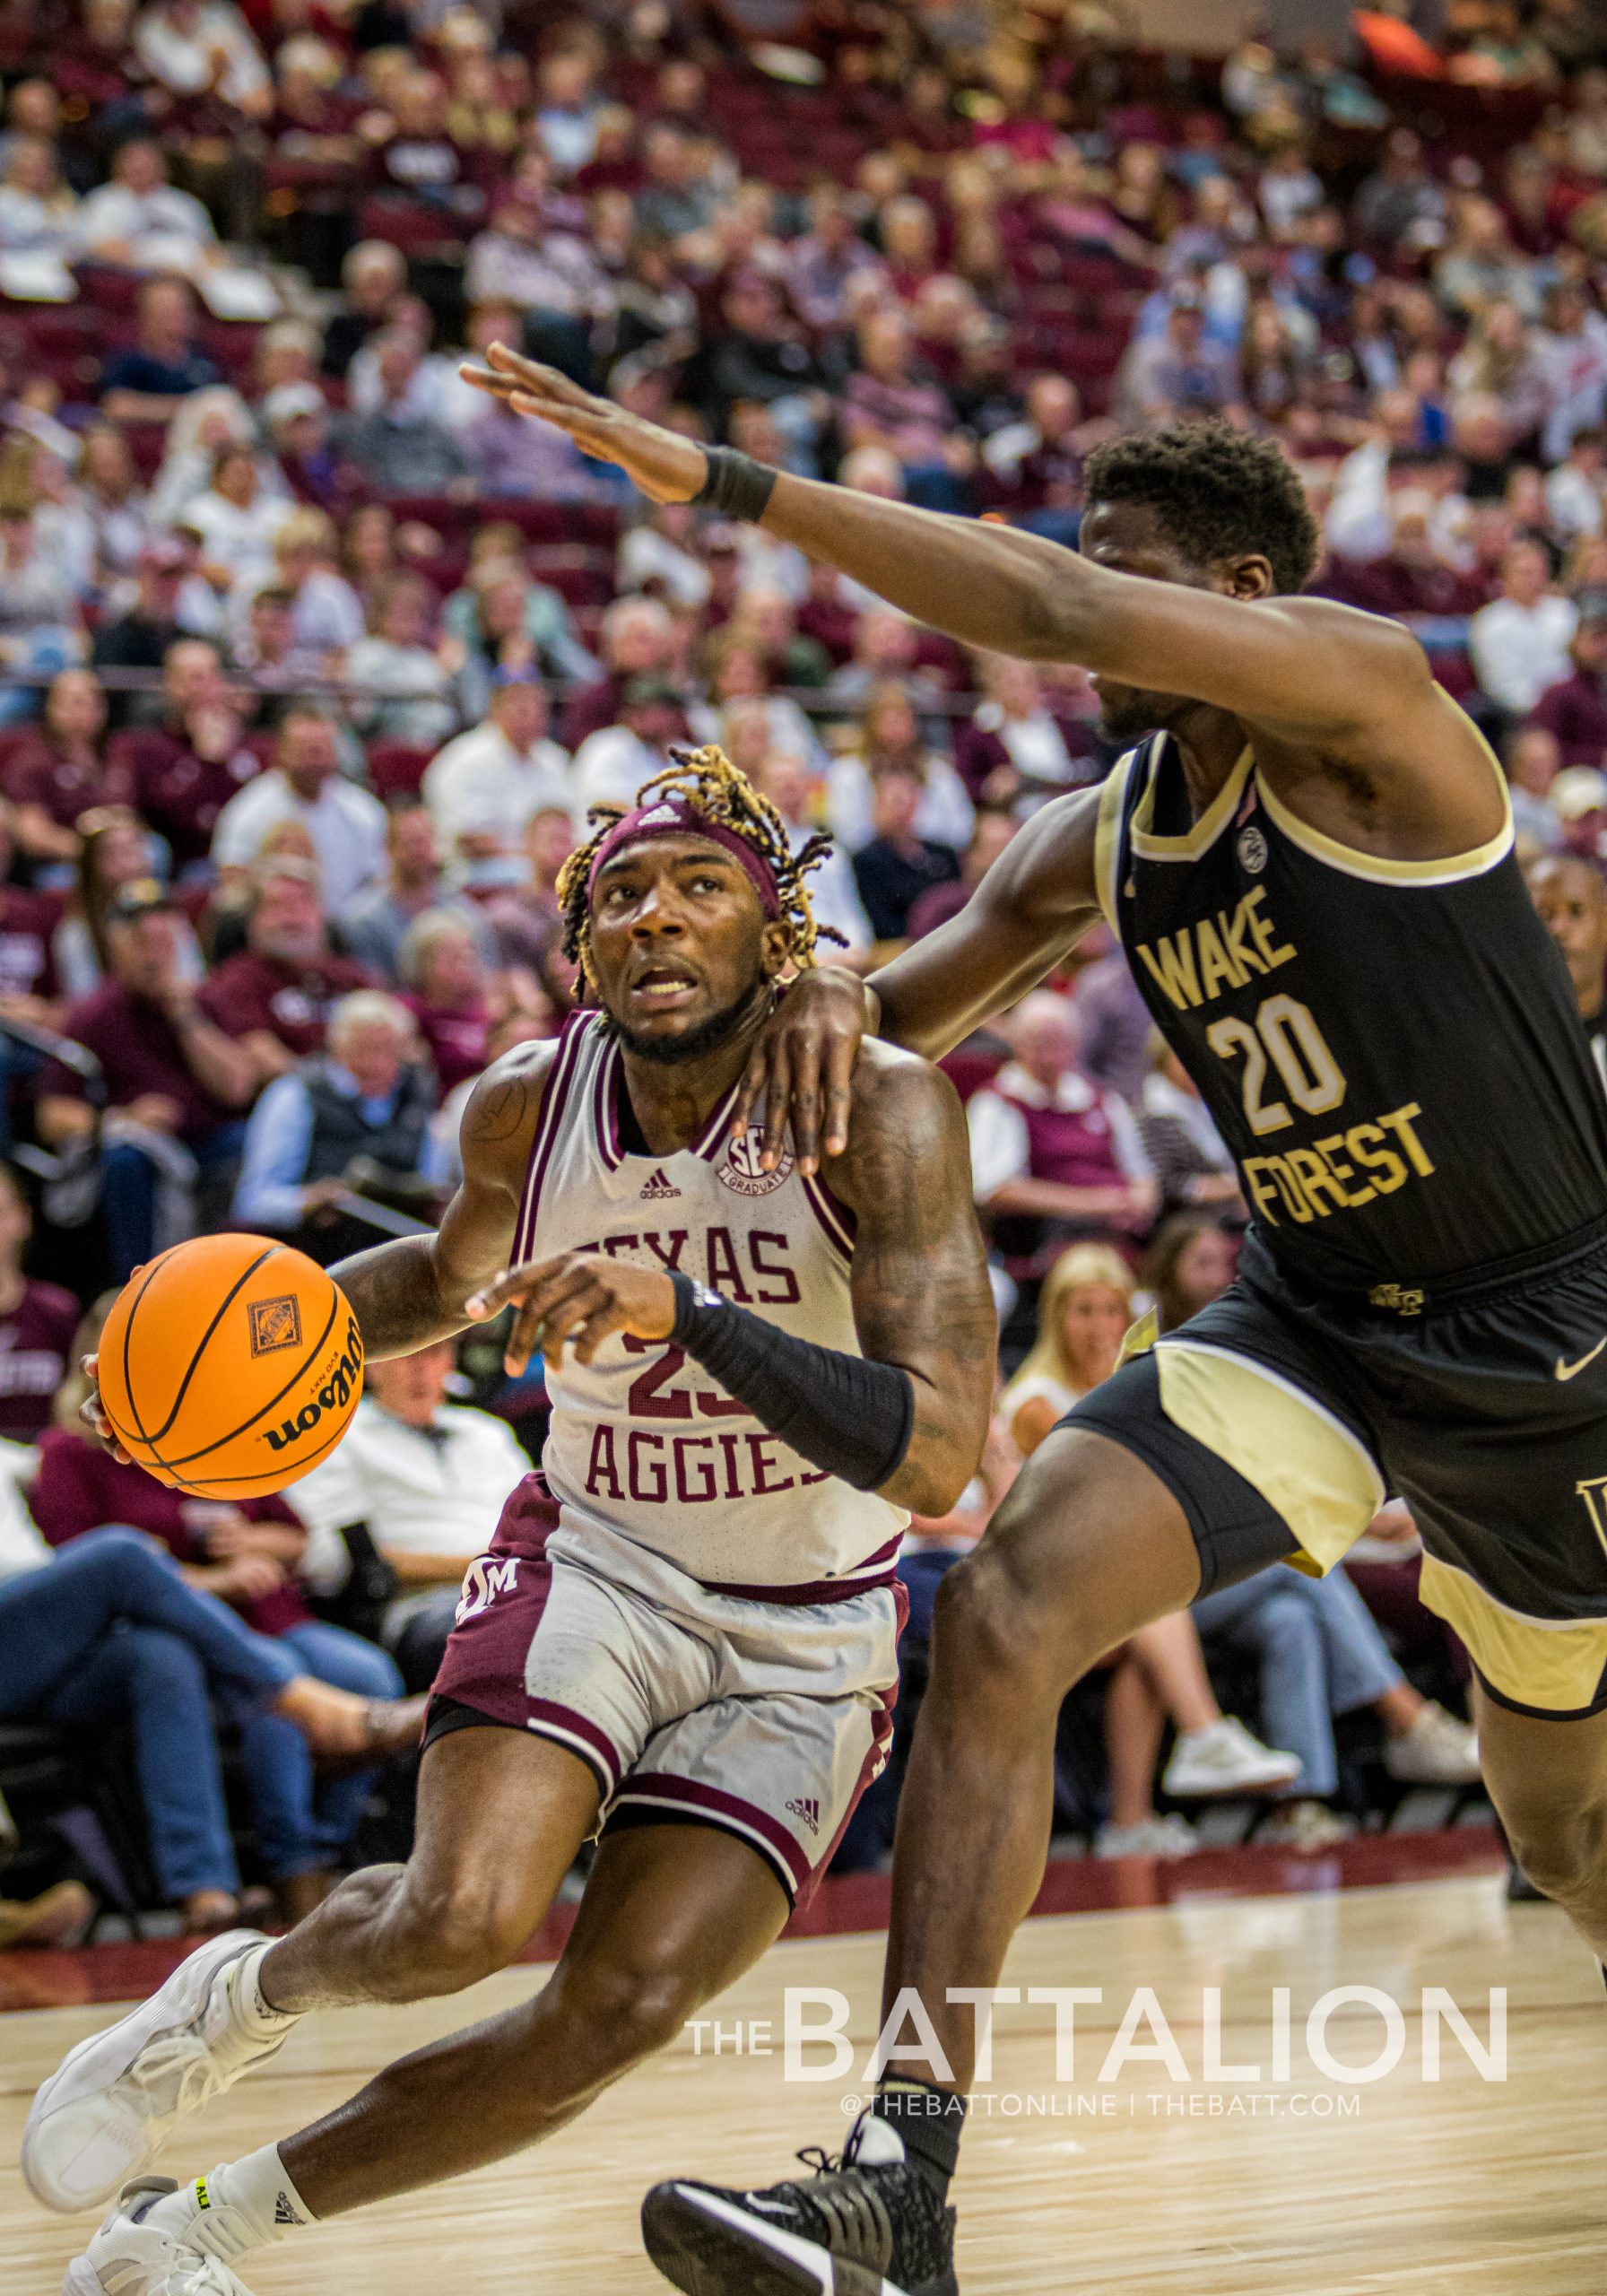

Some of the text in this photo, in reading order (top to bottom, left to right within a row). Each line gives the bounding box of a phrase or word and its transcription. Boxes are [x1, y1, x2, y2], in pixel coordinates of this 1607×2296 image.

[1135, 885, 1299, 1011] WAKE
[1205, 993, 1346, 1136] 20
[729, 1126, 765, 1177] SE
[1242, 1102, 1436, 1227] FOREST
[640, 1187, 682, 1199] adidas
[572, 1227, 801, 1303] XAS
[263, 1316, 364, 1451] Wilson
[310, 1351, 339, 1395] EVO NXT
[622, 1331, 754, 1419] 2
[585, 1423, 832, 1503] AGGIE
[786, 1800, 819, 1837] adidas
